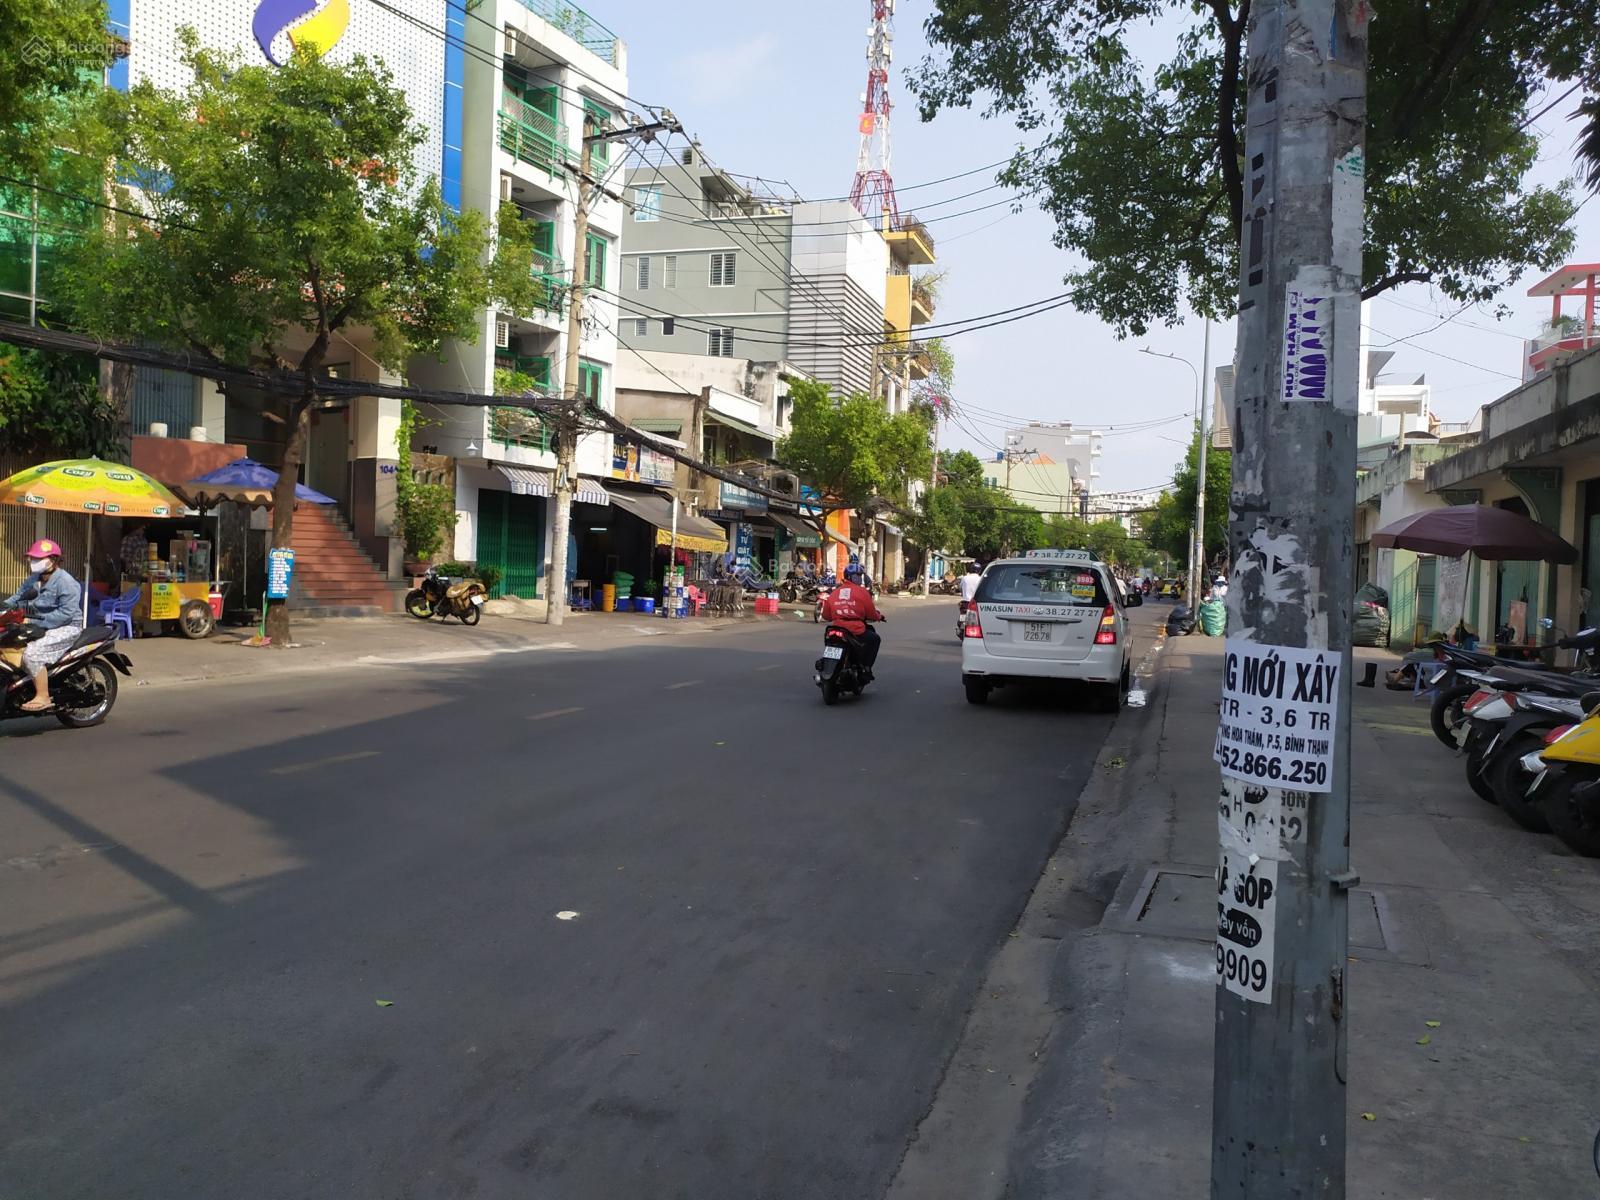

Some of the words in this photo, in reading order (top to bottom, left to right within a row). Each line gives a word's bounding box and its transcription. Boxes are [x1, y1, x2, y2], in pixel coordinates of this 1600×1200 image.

[979, 605, 1013, 613] VINASUN
[1088, 609, 1099, 617] 27
[1224, 652, 1238, 692] G
[1242, 649, 1286, 699] MỚI
[1291, 654, 1337, 704] XÂY
[1260, 706, 1297, 728] 3,6
[1308, 711, 1330, 731] TR
[1244, 728, 1265, 751] THÁM,
[1267, 735, 1282, 753] P.5,
[1285, 733, 1305, 753] BÌNH
[1307, 739, 1329, 758] THẠNH
[1236, 919, 1256, 943] vốn
